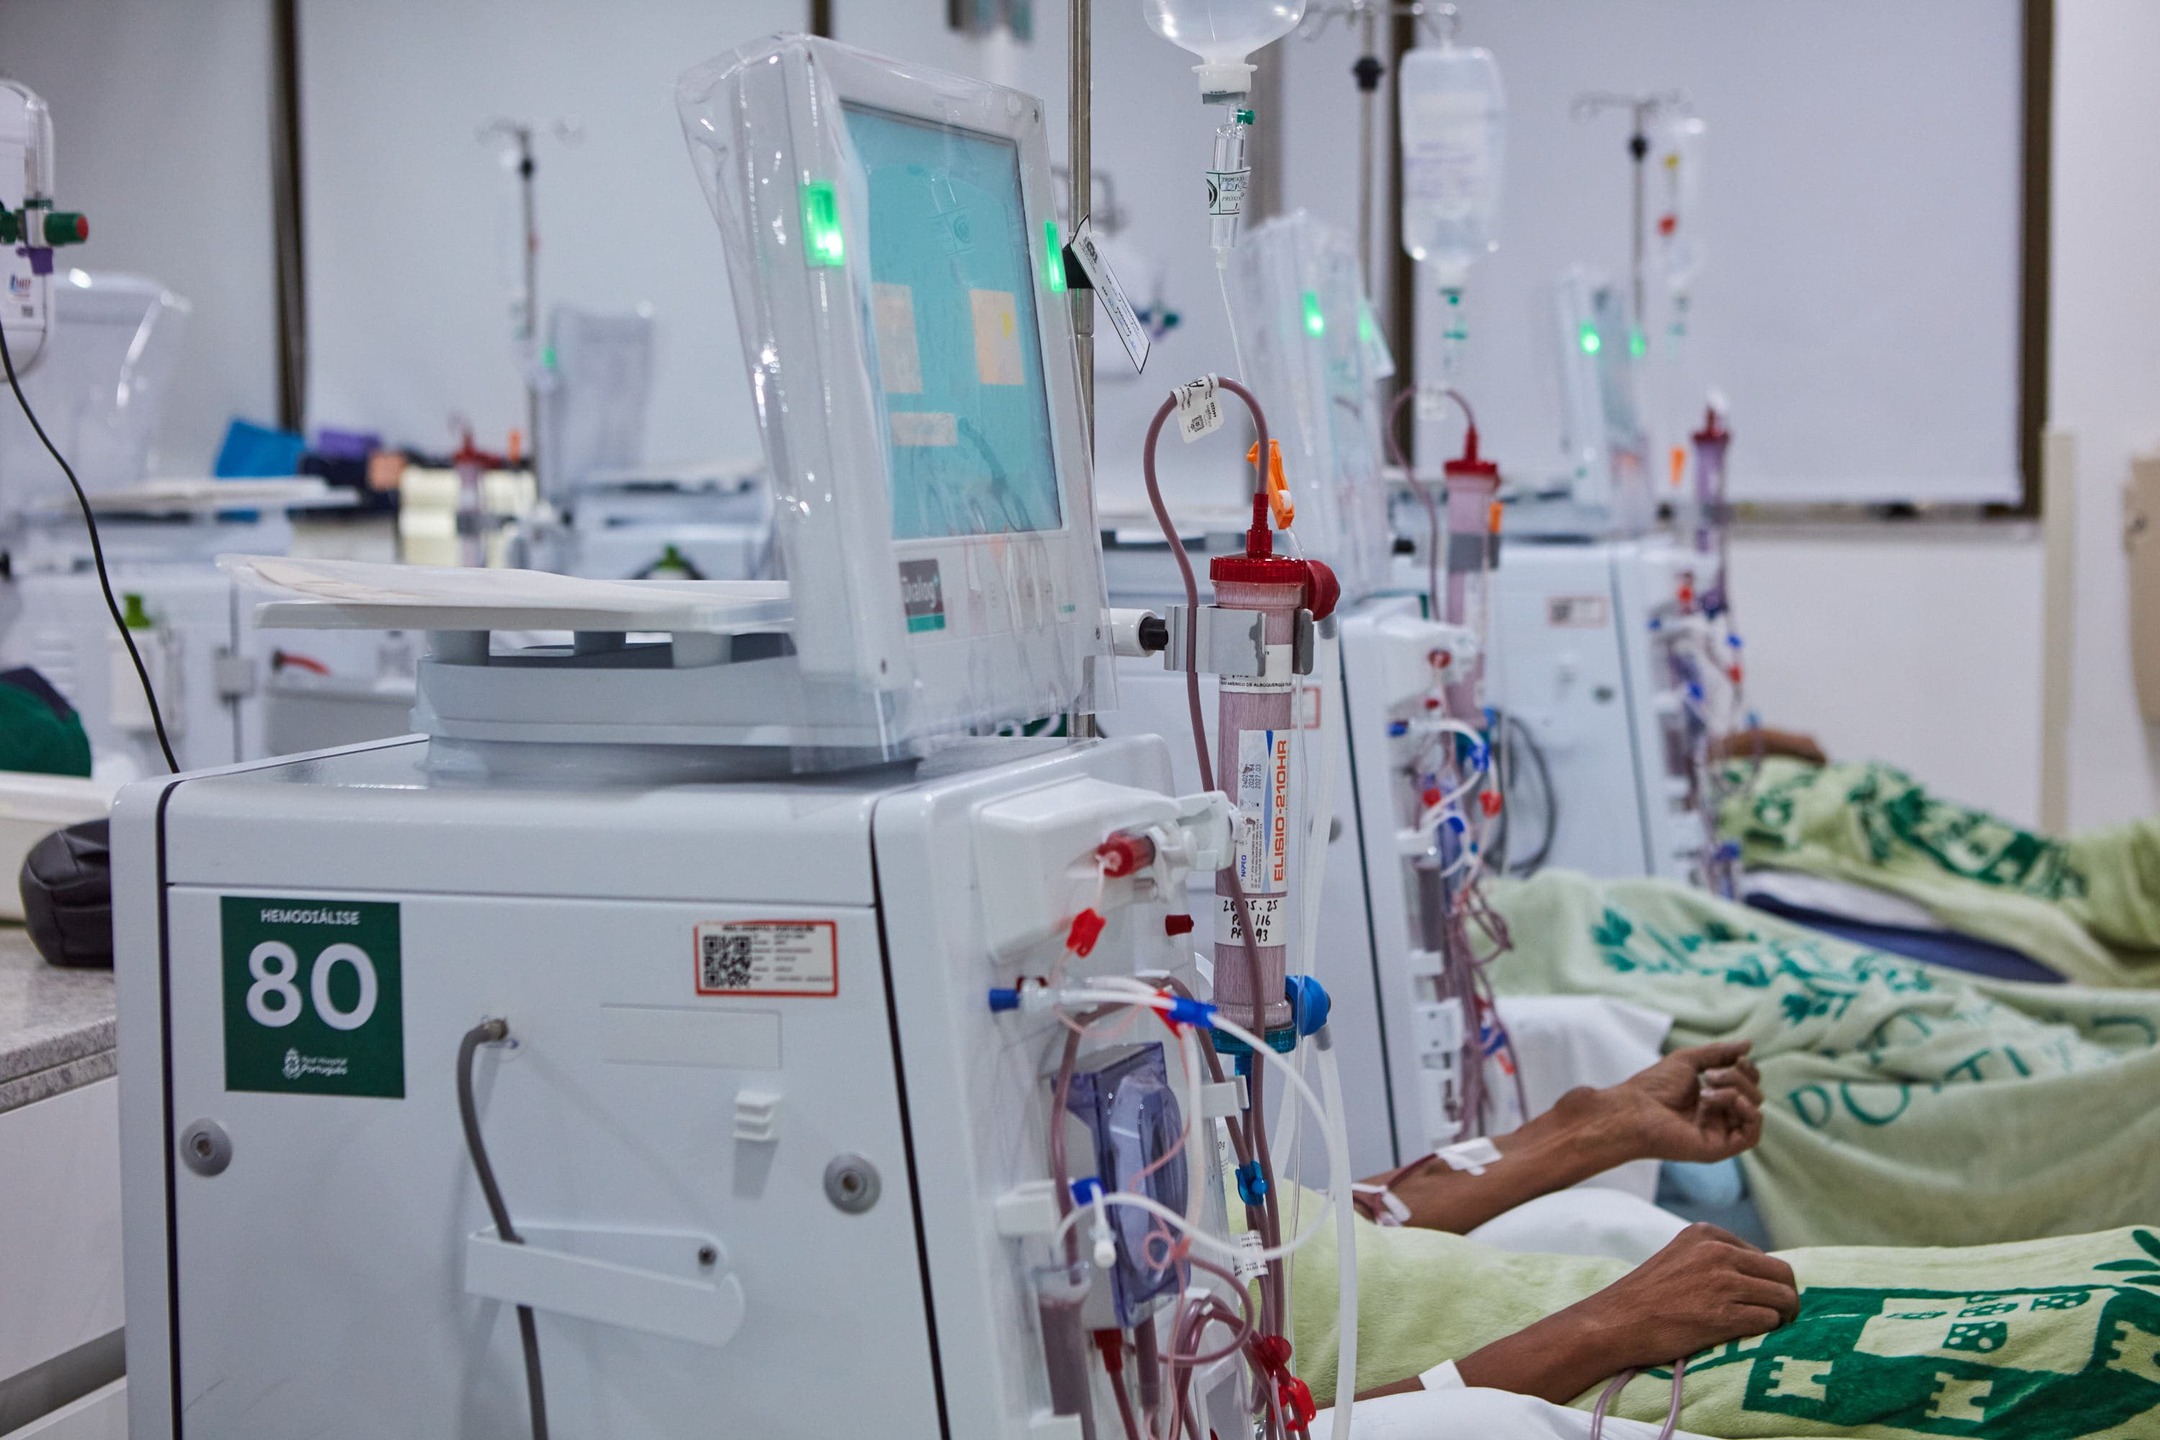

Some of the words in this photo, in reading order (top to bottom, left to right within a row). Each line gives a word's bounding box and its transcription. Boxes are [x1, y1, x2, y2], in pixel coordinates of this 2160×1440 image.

[1273, 739, 1287, 882] ELISIO-210HR
[260, 907, 361, 926] HEMODIÁLISE
[1255, 927, 1269, 943] 93
[244, 939, 379, 1031] 80
